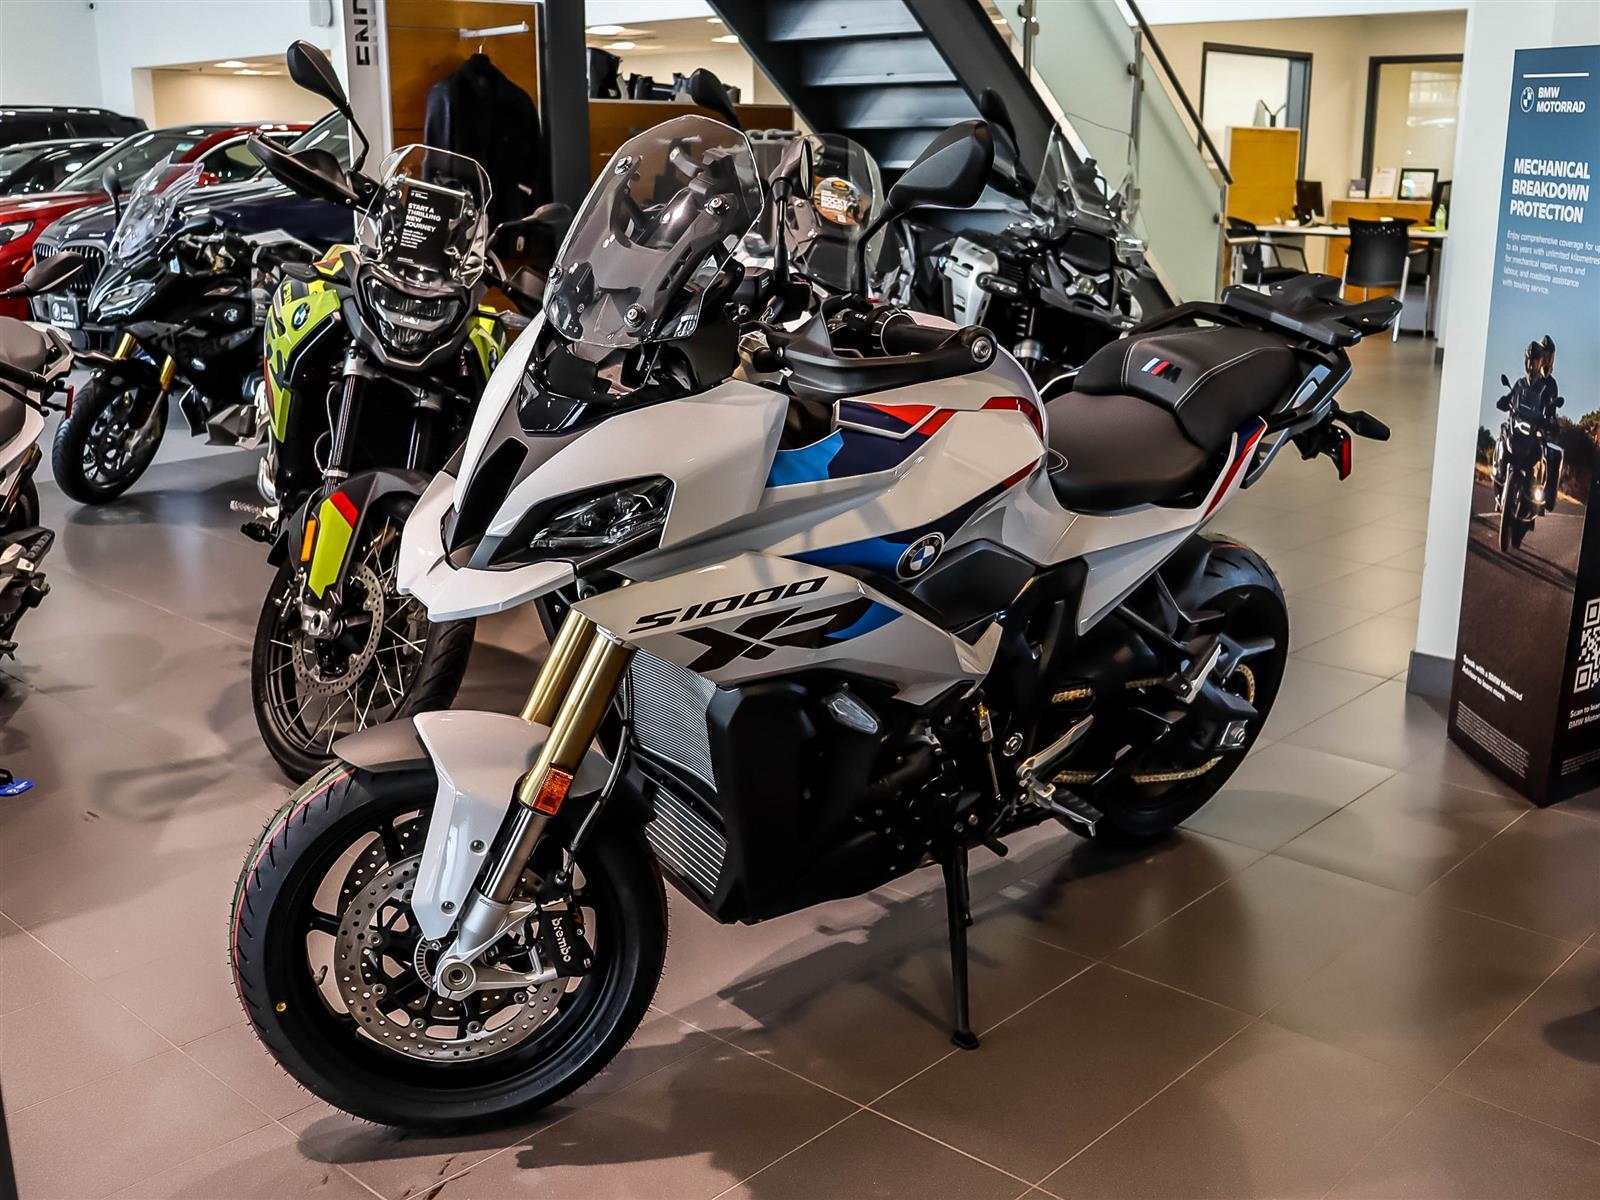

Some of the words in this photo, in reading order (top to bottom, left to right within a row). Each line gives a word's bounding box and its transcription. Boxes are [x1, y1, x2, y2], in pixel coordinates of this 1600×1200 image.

[1537, 86, 1561, 99] BMW
[1536, 100, 1586, 113] MOTORRAD
[1513, 157, 1591, 180] MECHANICAL
[1511, 178, 1590, 203] BREAKDOWN
[407, 208, 442, 222] THRILLING
[408, 202, 430, 212] START
[428, 206, 435, 214] A
[1509, 199, 1584, 224] PROTECTION
[404, 220, 436, 233] JOURNEY
[405, 214, 423, 223] NEW
[1507, 230, 1520, 241] Enjoy
[1520, 233, 1558, 246] comprehensive
[1558, 239, 1584, 251] coverage
[1584, 241, 1594, 251] for
[1505, 243, 1511, 251] to
[1519, 246, 1532, 255] years
[1532, 247, 1545, 256] with
[1545, 249, 1570, 260] unlimited
[1504, 254, 1512, 262] for
[1511, 256, 1539, 268] mechanical
[1559, 265, 1574, 274] parts
[1574, 267, 1586, 276] and
[1513, 280, 1530, 292] towing
[1519, 270, 1529, 278] and
[1529, 271, 1551, 282] roadside
[1551, 276, 1580, 288] assistance
[628, 575, 830, 635] S1000
[676, 596, 881, 673] XR
[1488, 672, 1501, 687] BMW
[1500, 680, 1523, 701] Motorrad
[1570, 709, 1584, 719] Scan
[1583, 706, 1590, 714] to
[1568, 717, 1585, 730] BMW
[551, 916, 572, 962] brembo
